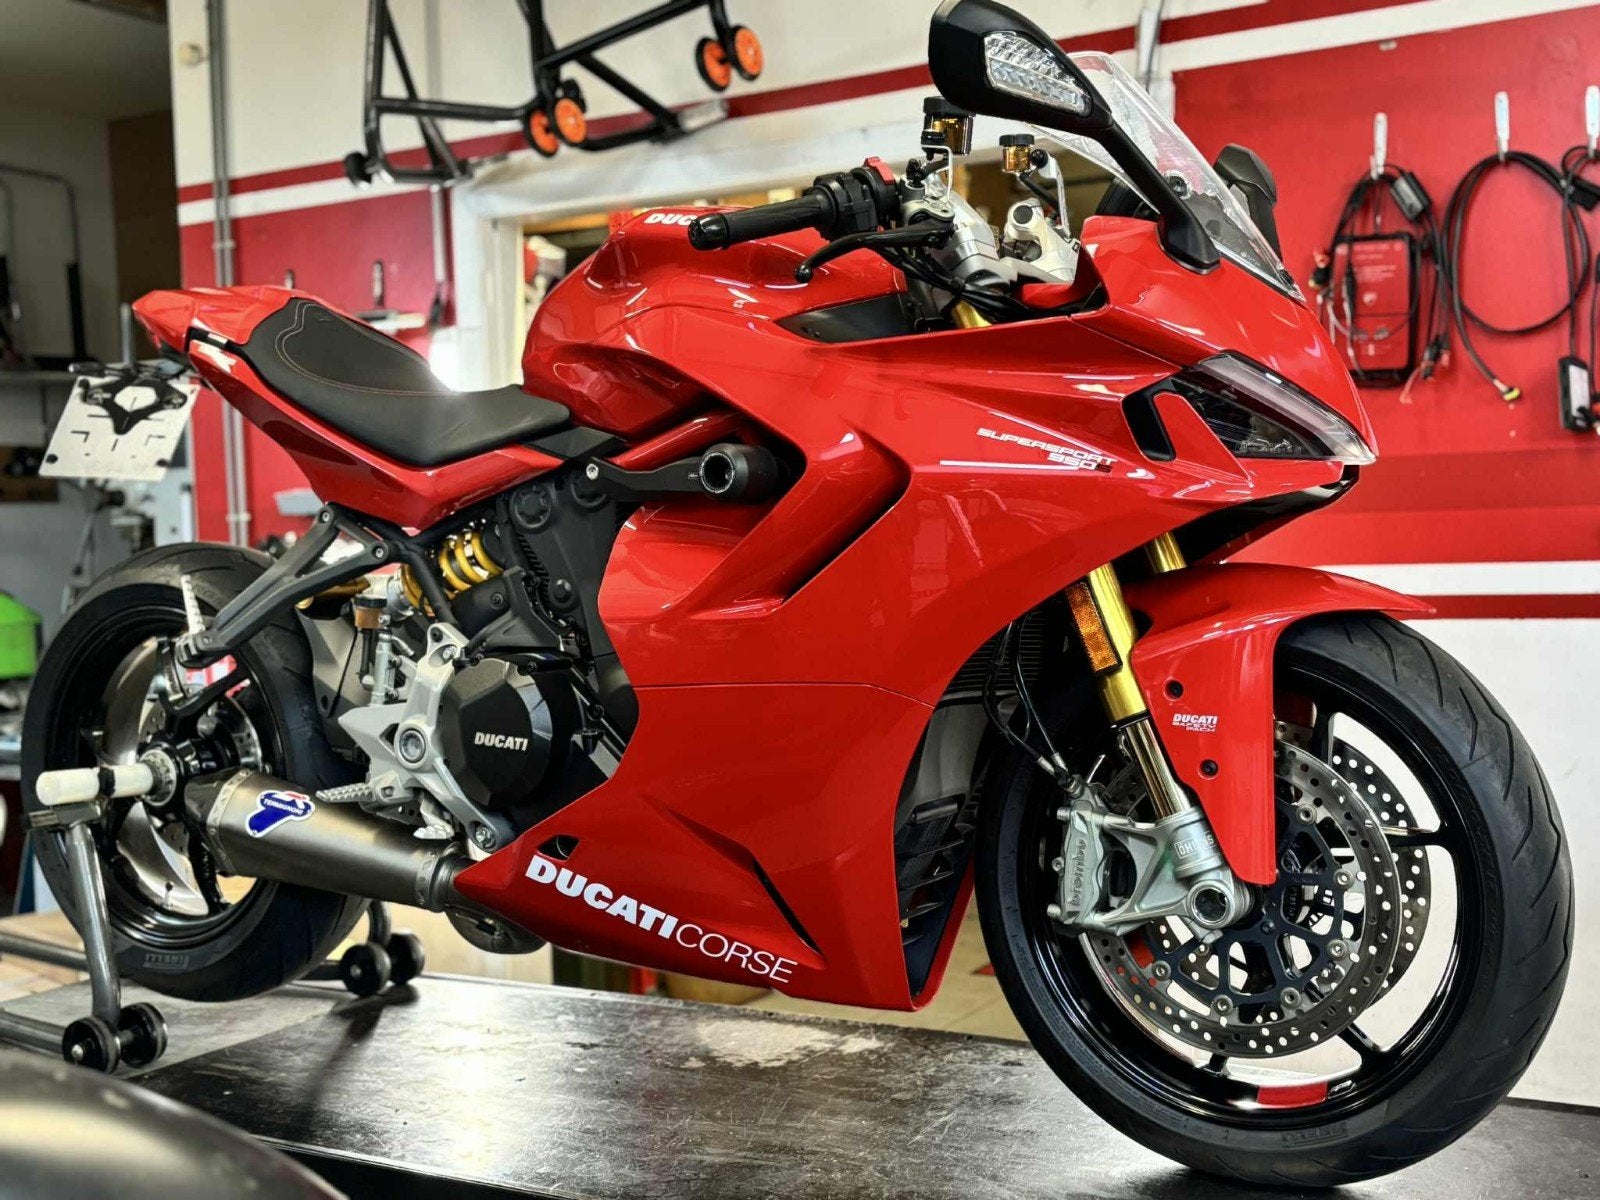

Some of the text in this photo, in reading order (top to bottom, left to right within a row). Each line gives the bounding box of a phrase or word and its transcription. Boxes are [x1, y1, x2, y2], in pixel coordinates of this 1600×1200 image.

[644, 213, 698, 226] DUC
[976, 427, 1118, 465] SUPERSPORT
[1173, 713, 1218, 725] DUCATI
[474, 731, 528, 751] DUCATI
[525, 854, 798, 983] DUCATI CORSE
